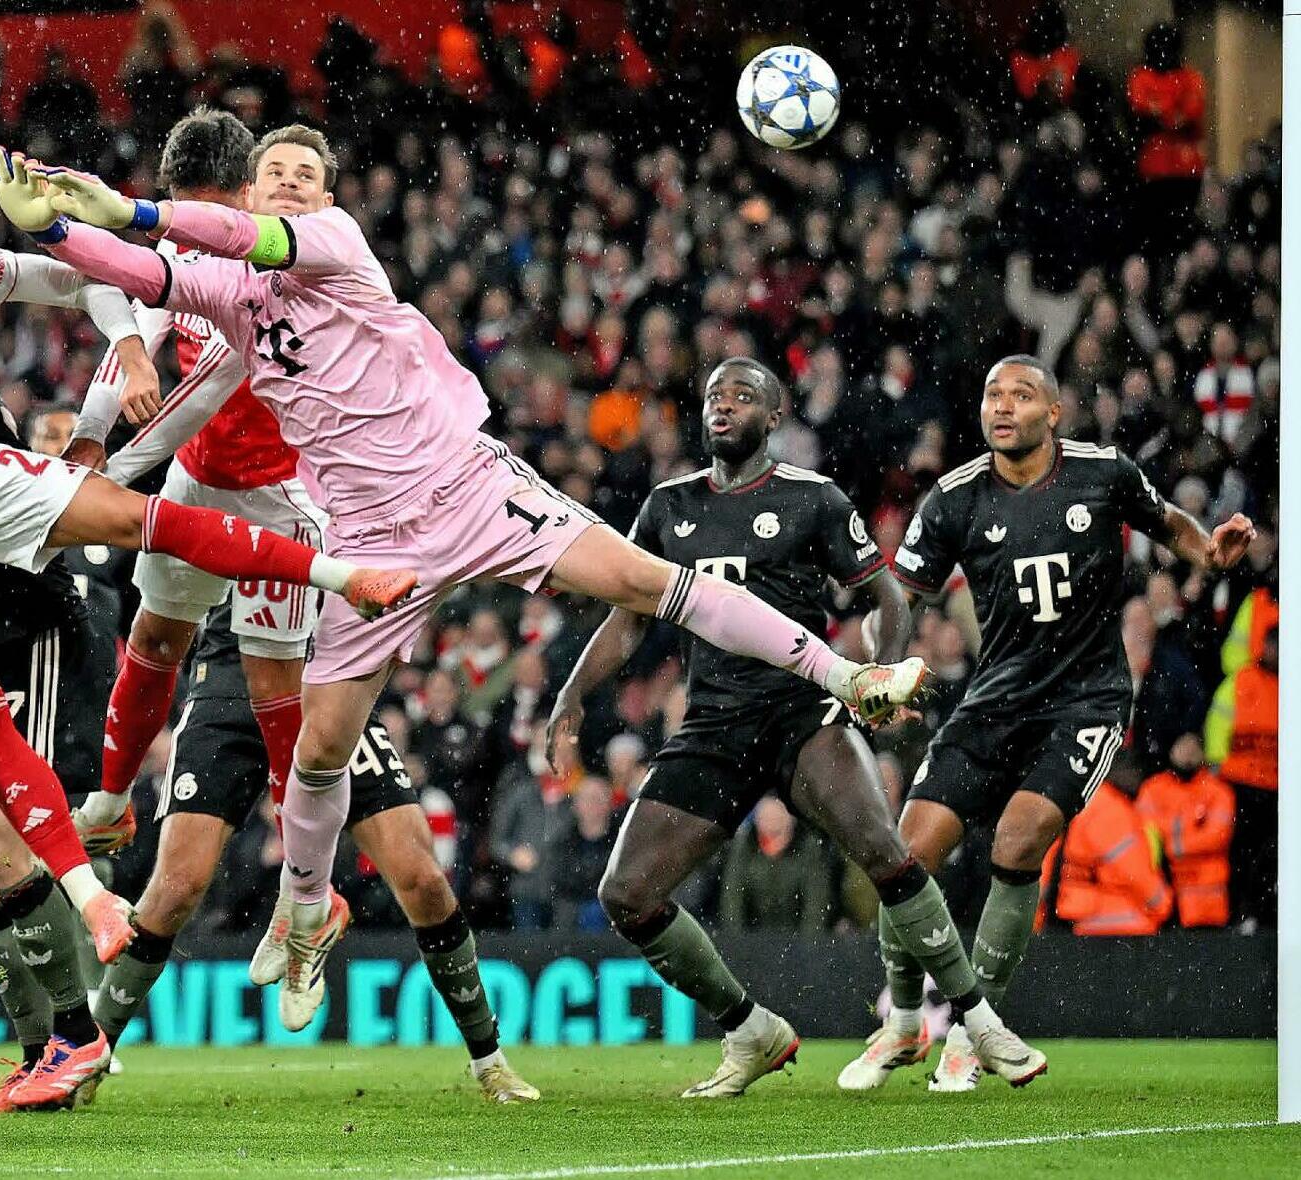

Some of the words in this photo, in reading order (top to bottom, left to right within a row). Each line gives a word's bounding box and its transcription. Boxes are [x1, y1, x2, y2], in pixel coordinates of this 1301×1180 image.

[504, 500, 549, 535] 1
[1013, 552, 1072, 622] T
[349, 726, 405, 777] 45
[1076, 725, 1109, 763] 4
